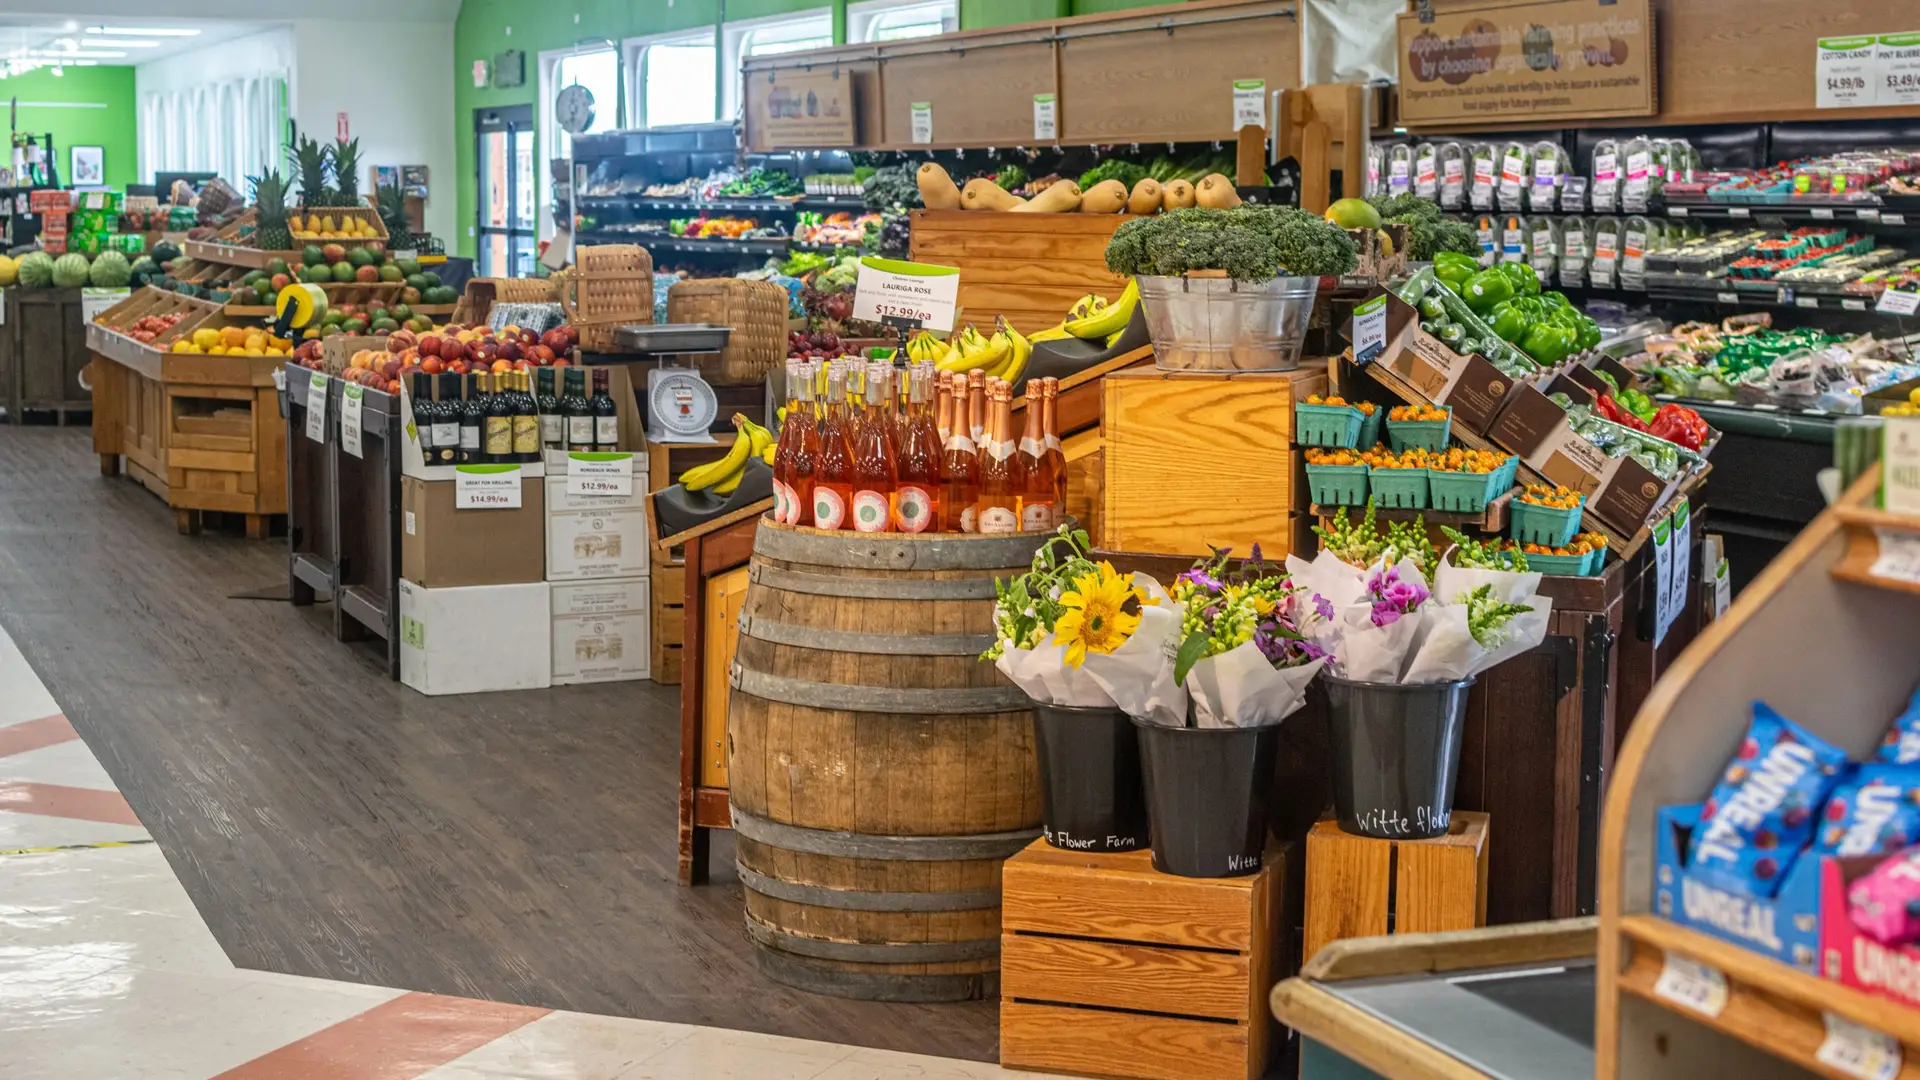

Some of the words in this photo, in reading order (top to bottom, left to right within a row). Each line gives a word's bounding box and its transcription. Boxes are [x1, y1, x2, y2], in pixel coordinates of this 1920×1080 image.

[1453, 24, 1520, 51] sustainable
[1523, 21, 1575, 45] farming
[1577, 15, 1640, 42] practices
[1420, 57, 1436, 79] by
[1438, 53, 1492, 77] choosing
[1495, 46, 1562, 75] organically
[1567, 48, 1617, 71] grown.
[1822, 52, 1847, 61] COTTON
[1849, 49, 1872, 59] CANDY
[1878, 50, 1893, 59] PINT
[1827, 77, 1865, 90] $4.99/lb
[882, 283, 912, 292] LAURIGA
[914, 287, 932, 295] ROSE
[875, 304, 932, 321] $12.99/ea
[581, 482, 618, 490] $12.99/ea
[471, 495, 508, 503] $14.99/ea
[1696, 741, 1814, 863] UNREAL
[1057, 831, 1096, 849] Flower
[1106, 835, 1135, 848] Farm
[1228, 855, 1259, 872] Witte
[1682, 877, 1784, 952] UNREAL
